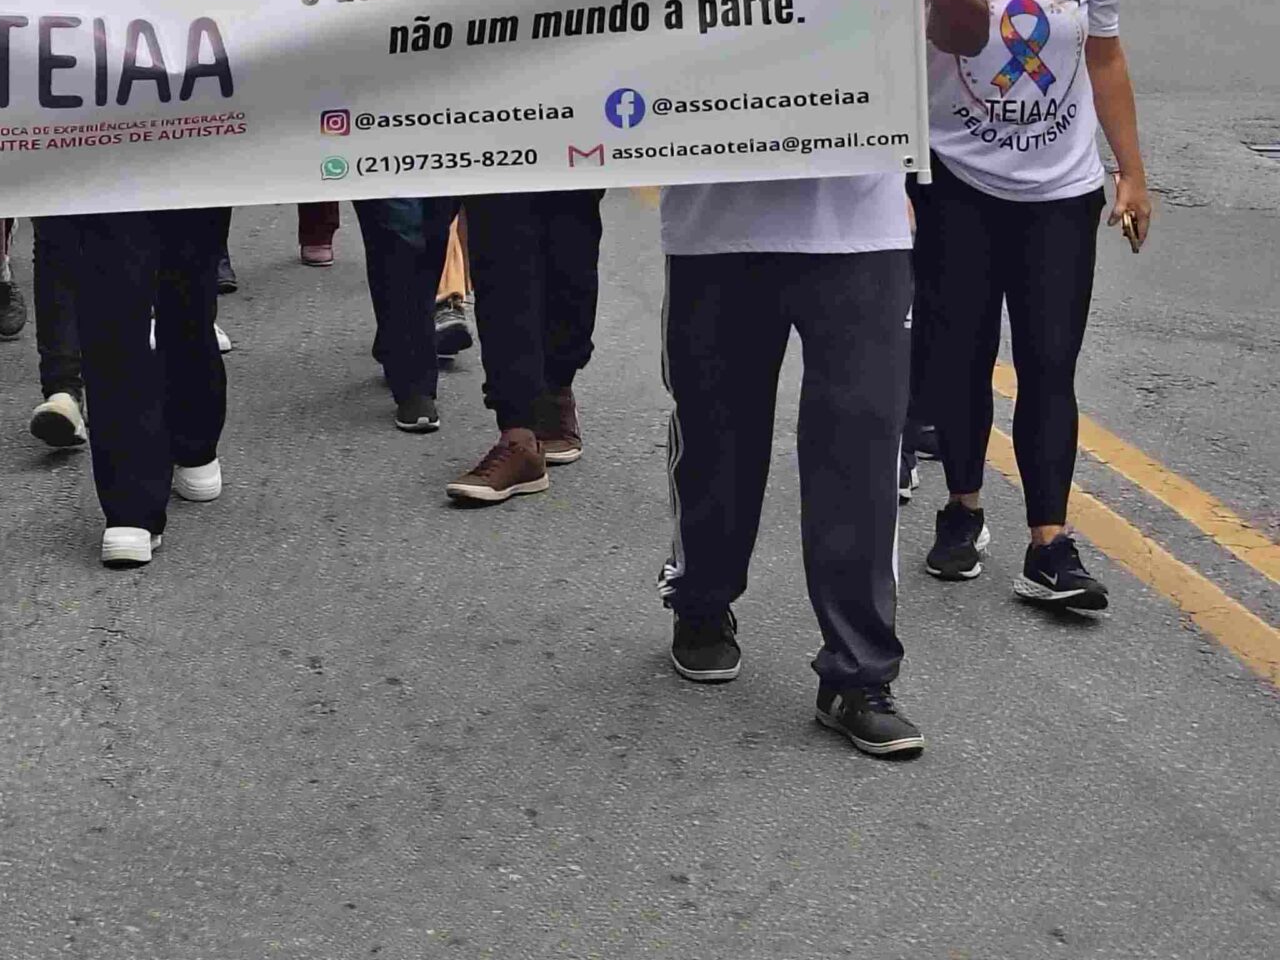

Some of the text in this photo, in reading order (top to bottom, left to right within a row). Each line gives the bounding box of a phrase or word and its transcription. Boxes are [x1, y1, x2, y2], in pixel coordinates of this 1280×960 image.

[389, 15, 453, 54] não
[466, 15, 519, 46] um
[33, 126, 50, 135] DE
[53, 120, 146, 135] EXPERIÊNCIAS
[150, 119, 157, 128] E
[161, 111, 245, 128] INTEGRAÇÃO
[355, 88, 870, 130] @associacaoteiaa @associacaoteiaa
[955, 103, 1078, 152] PELO AUTISMO
[986, 98, 1059, 124] TEIAA
[46, 134, 122, 150] AMIGOS
[129, 131, 151, 143] DE
[158, 123, 247, 141] AUTISTAS
[356, 132, 909, 177] (21)97335-8220 associacaoteiaa@gmail.com
